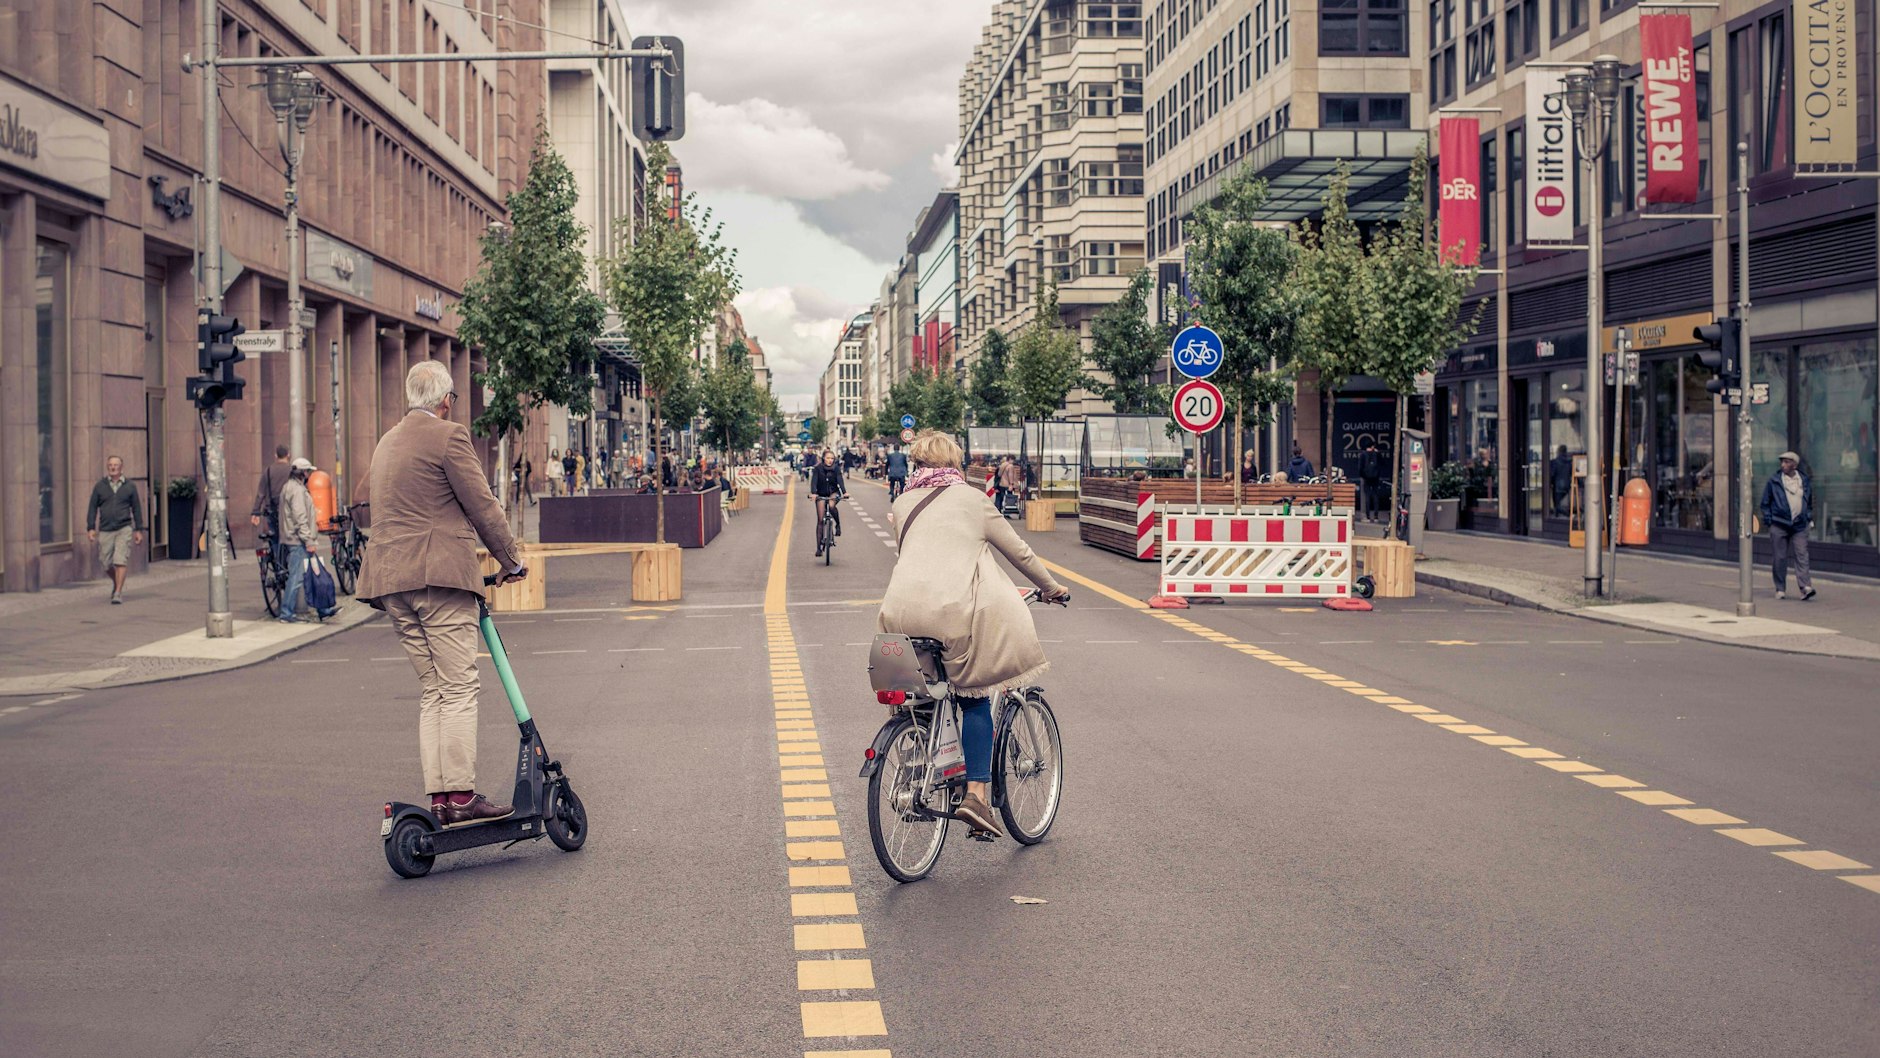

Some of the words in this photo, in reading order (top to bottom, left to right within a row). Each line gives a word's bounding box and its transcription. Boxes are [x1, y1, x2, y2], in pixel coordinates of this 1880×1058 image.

[1678, 46, 1691, 83] CITY
[1837, 87, 1848, 108] EN
[1646, 57, 1684, 171] REWE
[1537, 94, 1563, 181] iittala
[1442, 183, 1478, 201] DER
[1185, 396, 1212, 417] 20
[1342, 422, 1390, 431] QUARTIER
[1342, 433, 1390, 450] 205
